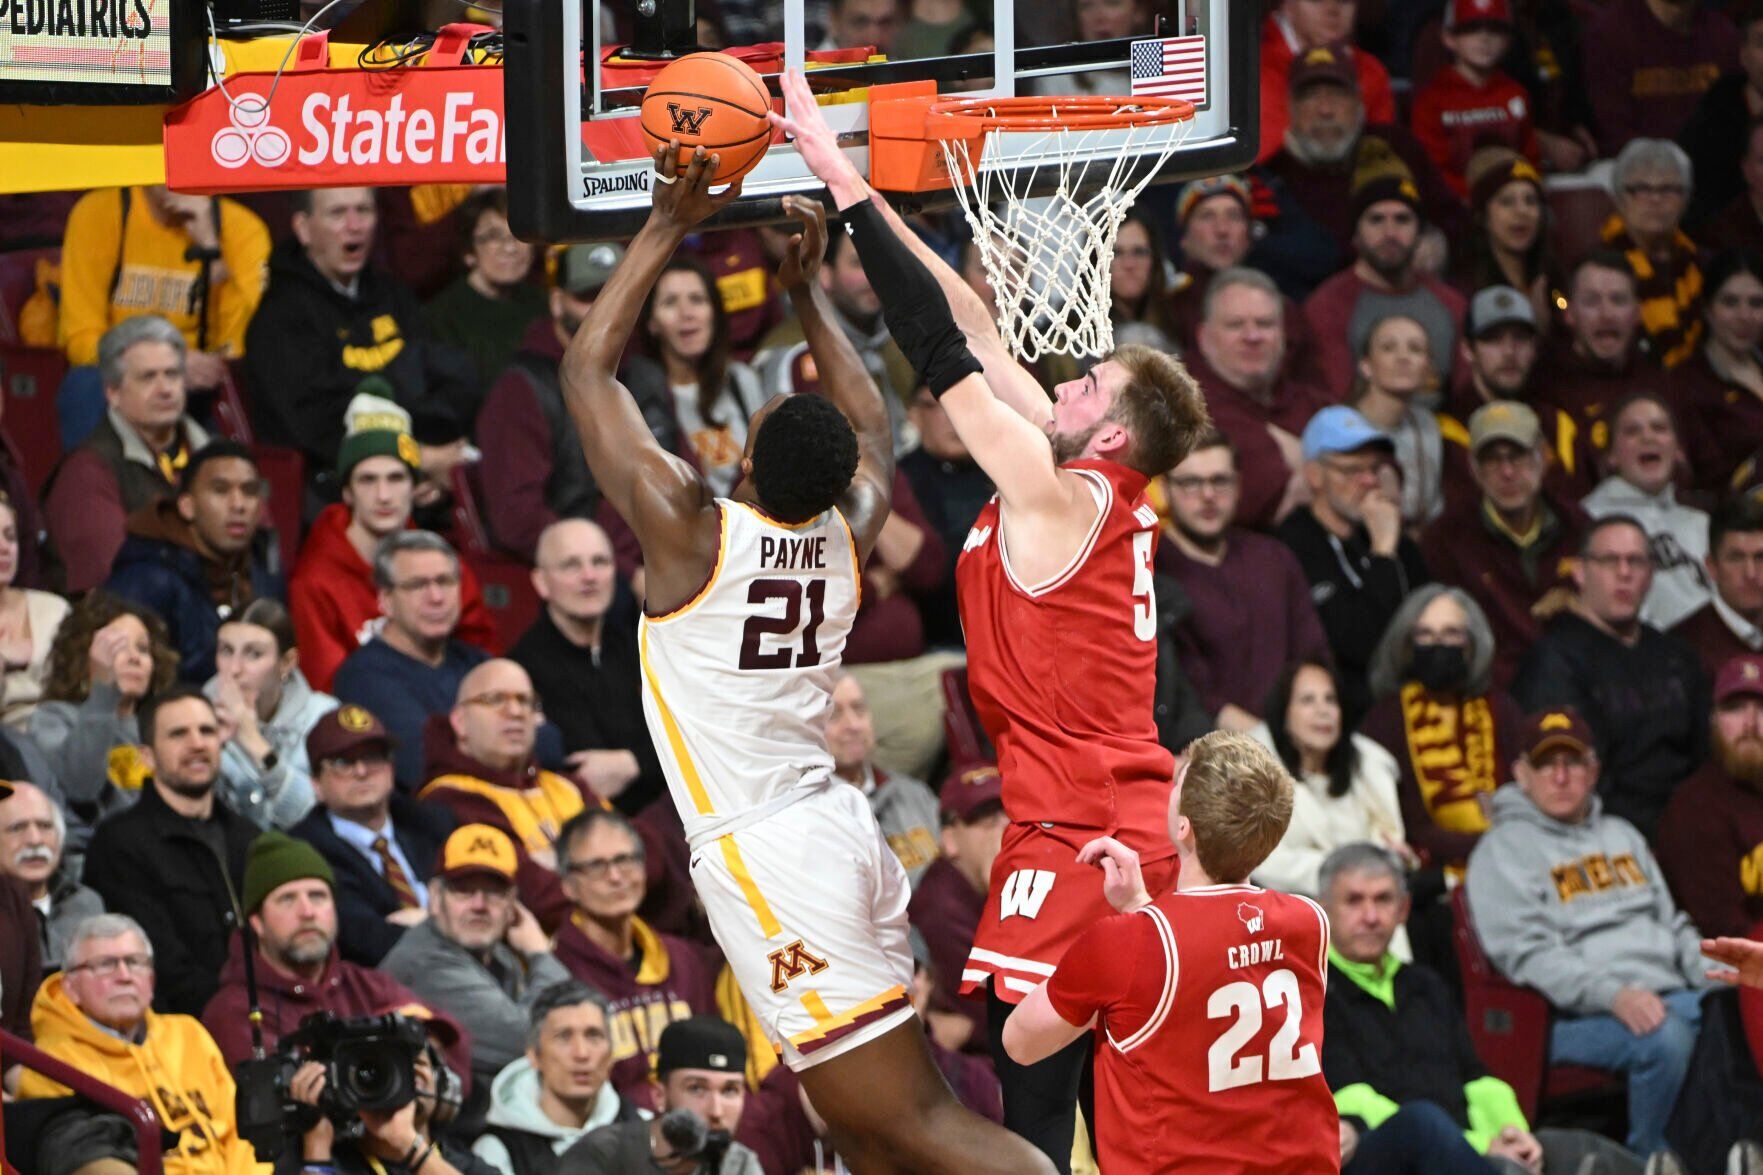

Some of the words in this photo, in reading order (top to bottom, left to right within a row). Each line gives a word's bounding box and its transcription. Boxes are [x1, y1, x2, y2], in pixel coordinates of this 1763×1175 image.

[298, 91, 436, 166] State
[440, 91, 507, 165] Fa
[666, 102, 713, 136] W
[583, 170, 649, 198] SPALDING
[760, 536, 827, 569] PAYNE
[1132, 530, 1158, 642] 5
[738, 578, 826, 670] 21
[999, 868, 1057, 922] W
[766, 938, 830, 994] M
[1227, 938, 1284, 970] CROWL
[1206, 968, 1322, 1093] 22
